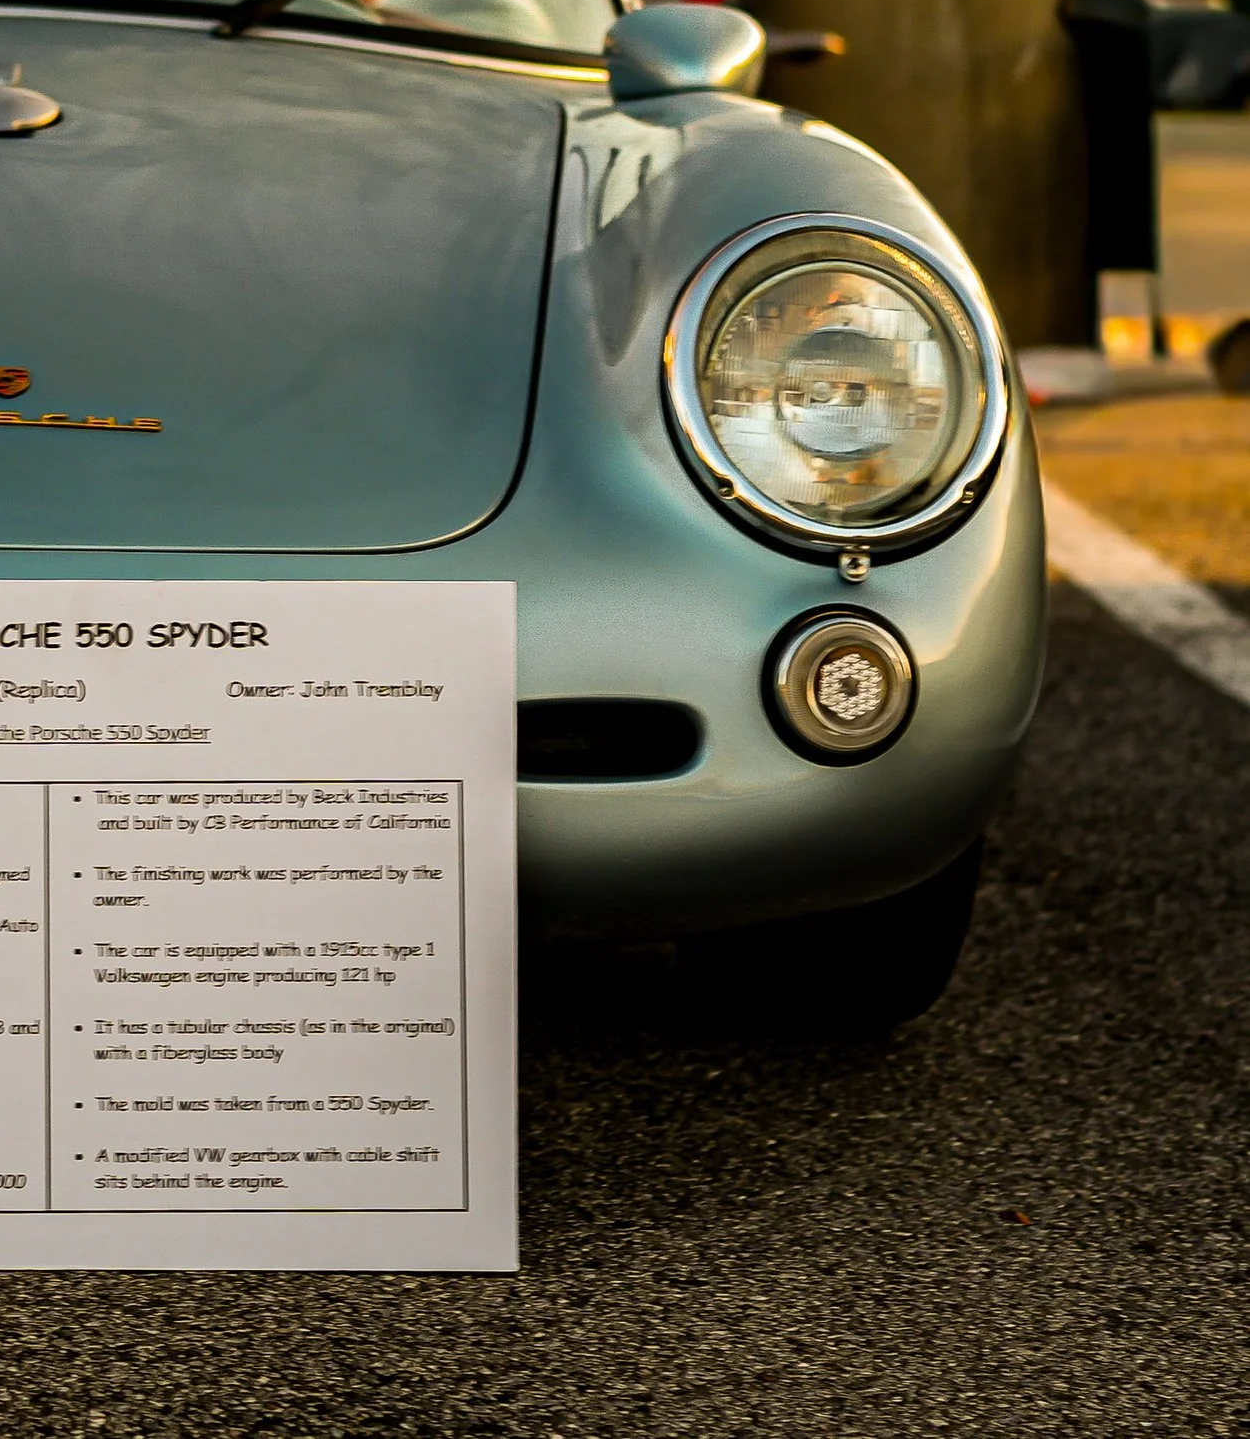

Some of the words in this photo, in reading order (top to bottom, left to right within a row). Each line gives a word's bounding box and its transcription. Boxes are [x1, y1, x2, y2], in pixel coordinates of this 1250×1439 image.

[74, 622, 135, 649] 550
[144, 620, 270, 649] SPYDER
[222, 680, 295, 699] Owner:
[298, 680, 349, 699] John
[351, 679, 445, 702] Tremblay
[28, 723, 104, 741] Porsche
[104, 724, 143, 741] 550
[144, 723, 212, 743] Spyder
[91, 789, 132, 805] This
[133, 793, 165, 805] car
[165, 793, 200, 805] was
[202, 788, 283, 810] produced
[285, 788, 310, 809] by
[311, 788, 355, 805] Beck
[356, 788, 450, 804] Industries
[96, 814, 130, 831] and
[132, 814, 174, 831] built
[176, 814, 200, 835] by
[228, 813, 342, 831] Performance
[341, 813, 365, 831] of
[366, 813, 452, 830] California
[92, 865, 129, 882] The
[129, 865, 206, 886] finishing
[207, 864, 252, 881] work
[253, 869, 288, 881] was
[289, 864, 384, 886] performed
[385, 864, 410, 885] by
[410, 864, 444, 881] the
[92, 895, 150, 907] owner.
[92, 942, 129, 958] The
[130, 946, 162, 958] car
[163, 942, 181, 958] is
[182, 941, 260, 962] equipped
[261, 941, 302, 957] with
[303, 946, 317, 958] a
[381, 942, 423, 962] type
[424, 941, 436, 957] 1
[92, 967, 192, 988] Volkswagen
[193, 968, 252, 988] engine
[252, 967, 338, 988] producing
[340, 967, 371, 983] 121
[373, 966, 397, 987] hp
[7, 1019, 41, 1036] and
[93, 1019, 115, 1035] It
[117, 1018, 149, 1035] has
[150, 1023, 164, 1035] a
[165, 1018, 231, 1035] tubular
[232, 1018, 297, 1034] chassis
[298, 1018, 327, 1037] (as
[329, 1018, 347, 1034] in
[347, 1017, 382, 1034] the
[382, 1017, 456, 1039] original)
[92, 1044, 133, 1061] with
[134, 1049, 149, 1061] a
[148, 1044, 239, 1065] fiberglass
[241, 1043, 285, 1064] body
[93, 1096, 130, 1112] The
[131, 1095, 175, 1112] mold
[176, 1099, 211, 1112] was
[212, 1095, 264, 1112] taken
[265, 1094, 311, 1112] from
[311, 1100, 326, 1111] a
[327, 1095, 364, 1112] 550
[365, 1095, 436, 1116] Spyder.
[94, 1148, 110, 1163] A
[112, 1146, 190, 1164] modified
[192, 1147, 227, 1163] VW
[228, 1146, 302, 1168] gearbox
[302, 1146, 343, 1163] with
[344, 1146, 394, 1163] cable
[394, 1145, 442, 1163] shift
[93, 1174, 129, 1190] sits
[130, 1172, 191, 1189] behind
[192, 1172, 226, 1189] the
[227, 1173, 290, 1194] engine.
